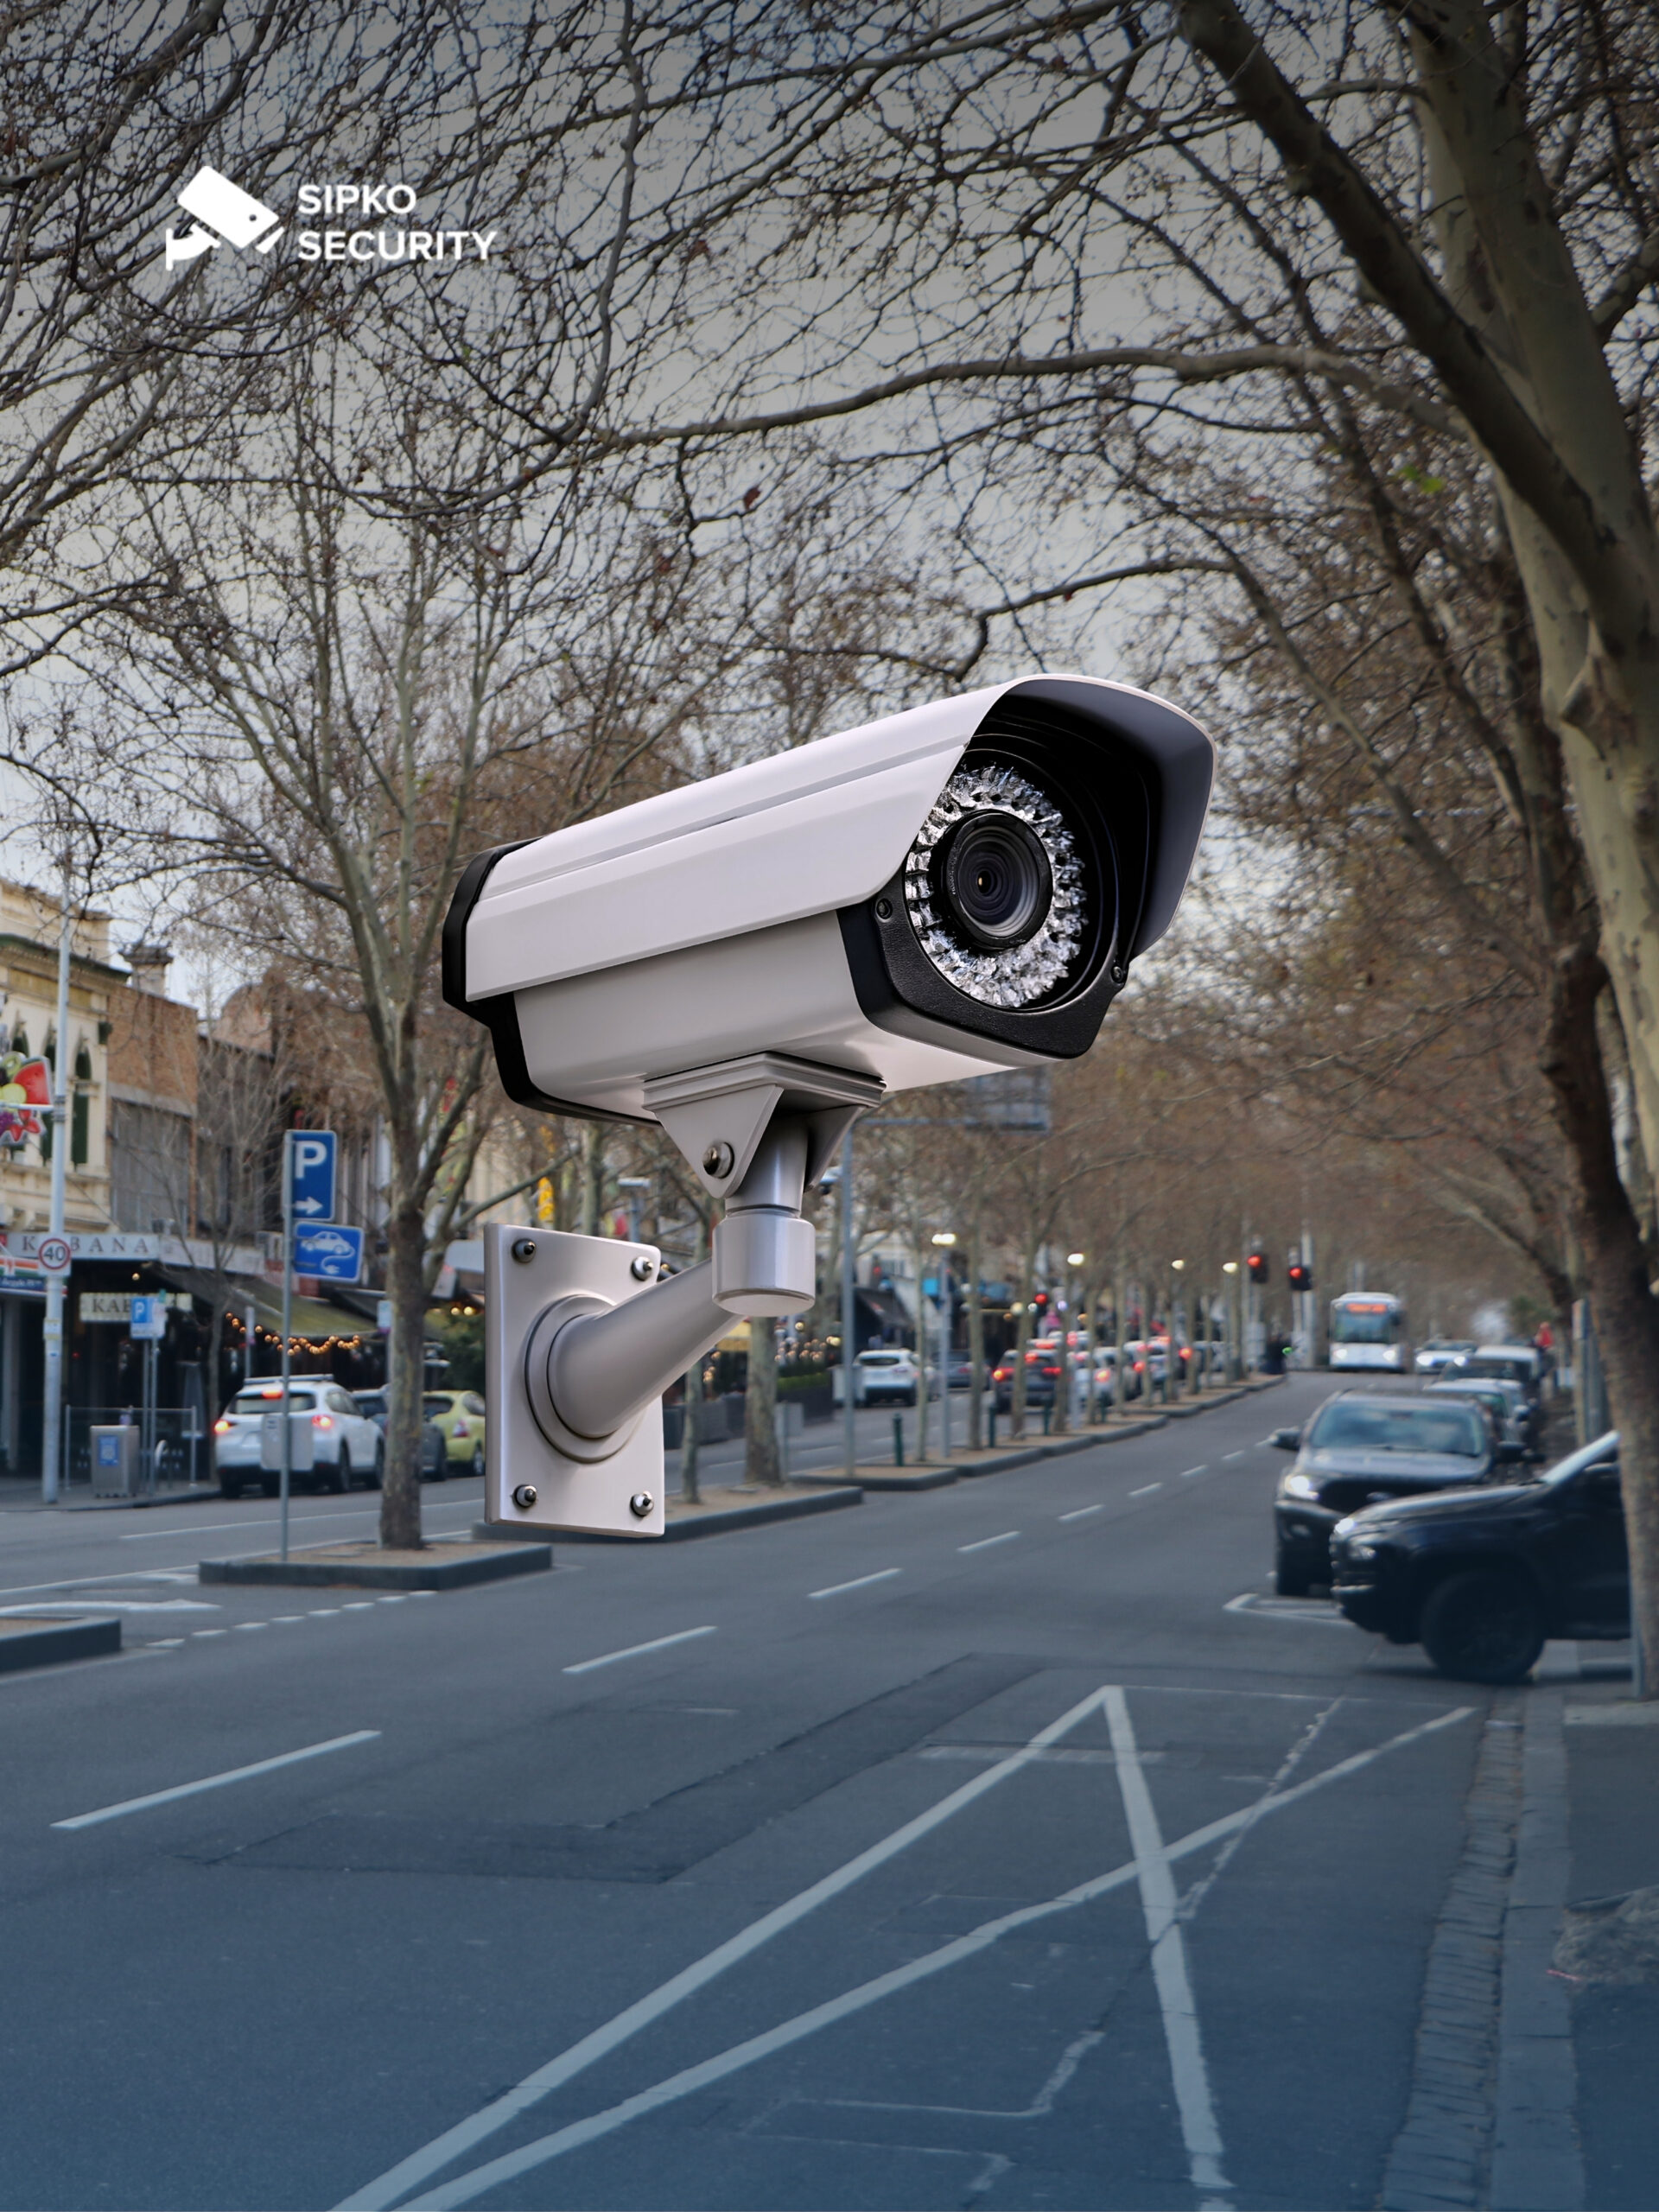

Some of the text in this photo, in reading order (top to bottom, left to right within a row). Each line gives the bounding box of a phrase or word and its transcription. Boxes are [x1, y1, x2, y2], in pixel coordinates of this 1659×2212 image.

[296, 1141, 327, 1179] P
[22, 1236, 149, 1253] KBANA
[43, 1246, 66, 1261] 40
[92, 1299, 131, 1313] KAB
[135, 1301, 145, 1320] P
